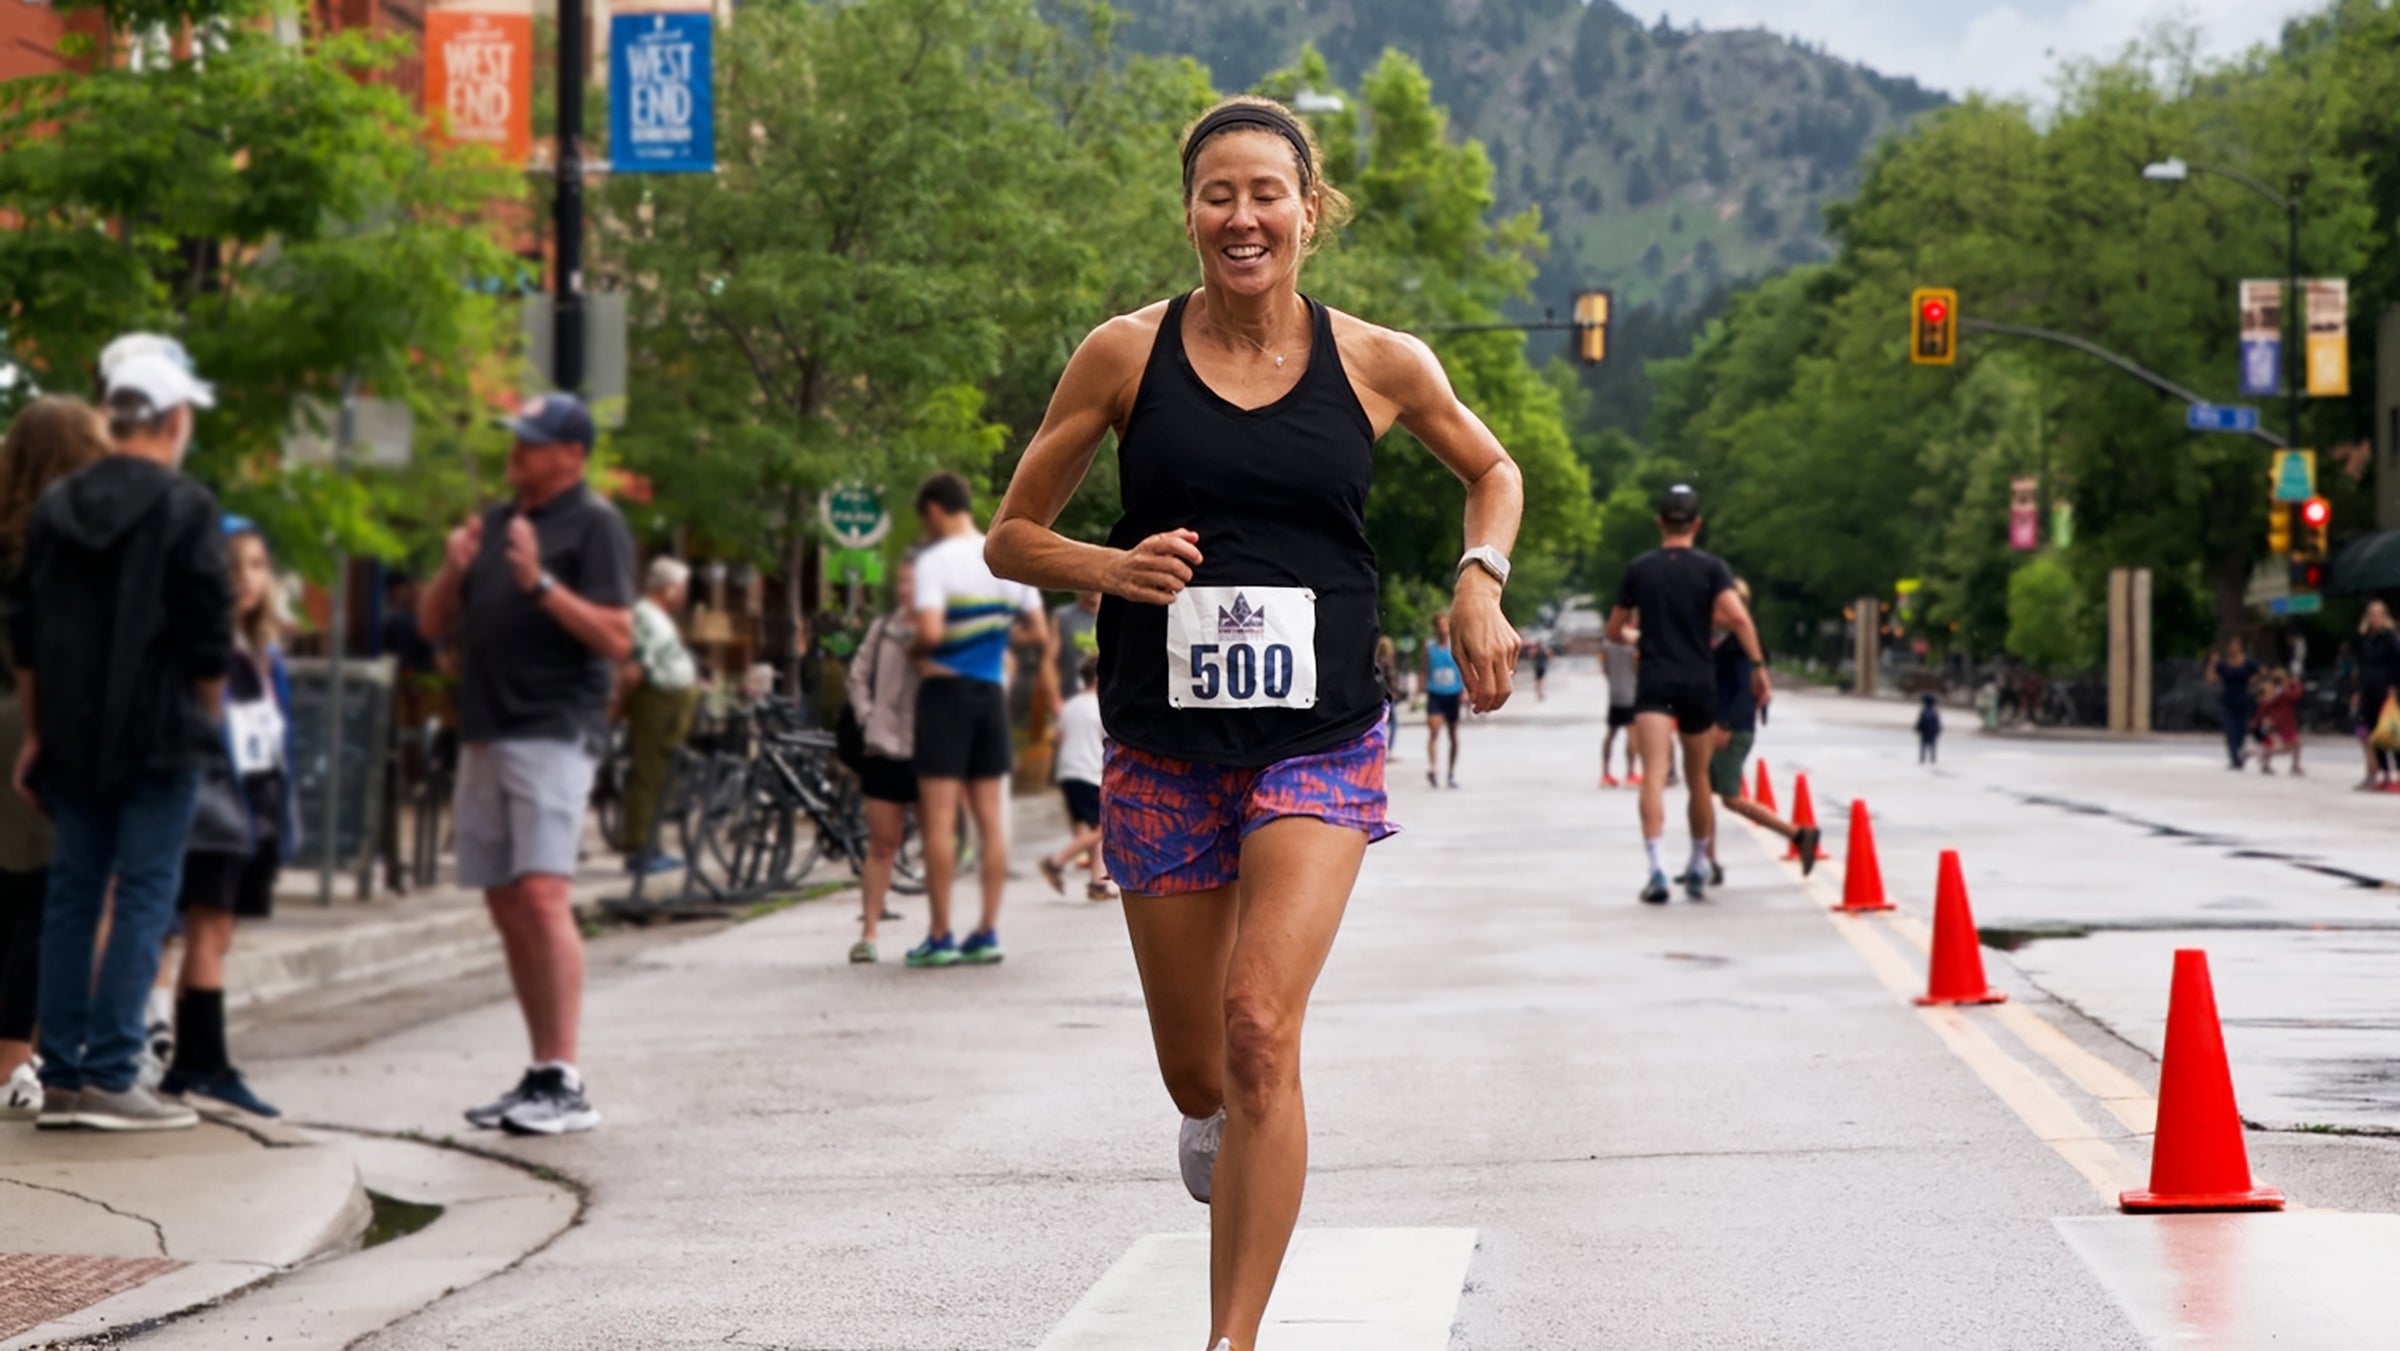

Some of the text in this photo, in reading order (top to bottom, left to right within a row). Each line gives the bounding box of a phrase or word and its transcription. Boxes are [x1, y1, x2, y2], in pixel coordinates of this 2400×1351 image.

[443, 42, 514, 82] WEST
[626, 42, 694, 82] WEST
[445, 82, 510, 125] END
[629, 82, 692, 126] END
[1190, 643, 1293, 700] 500
